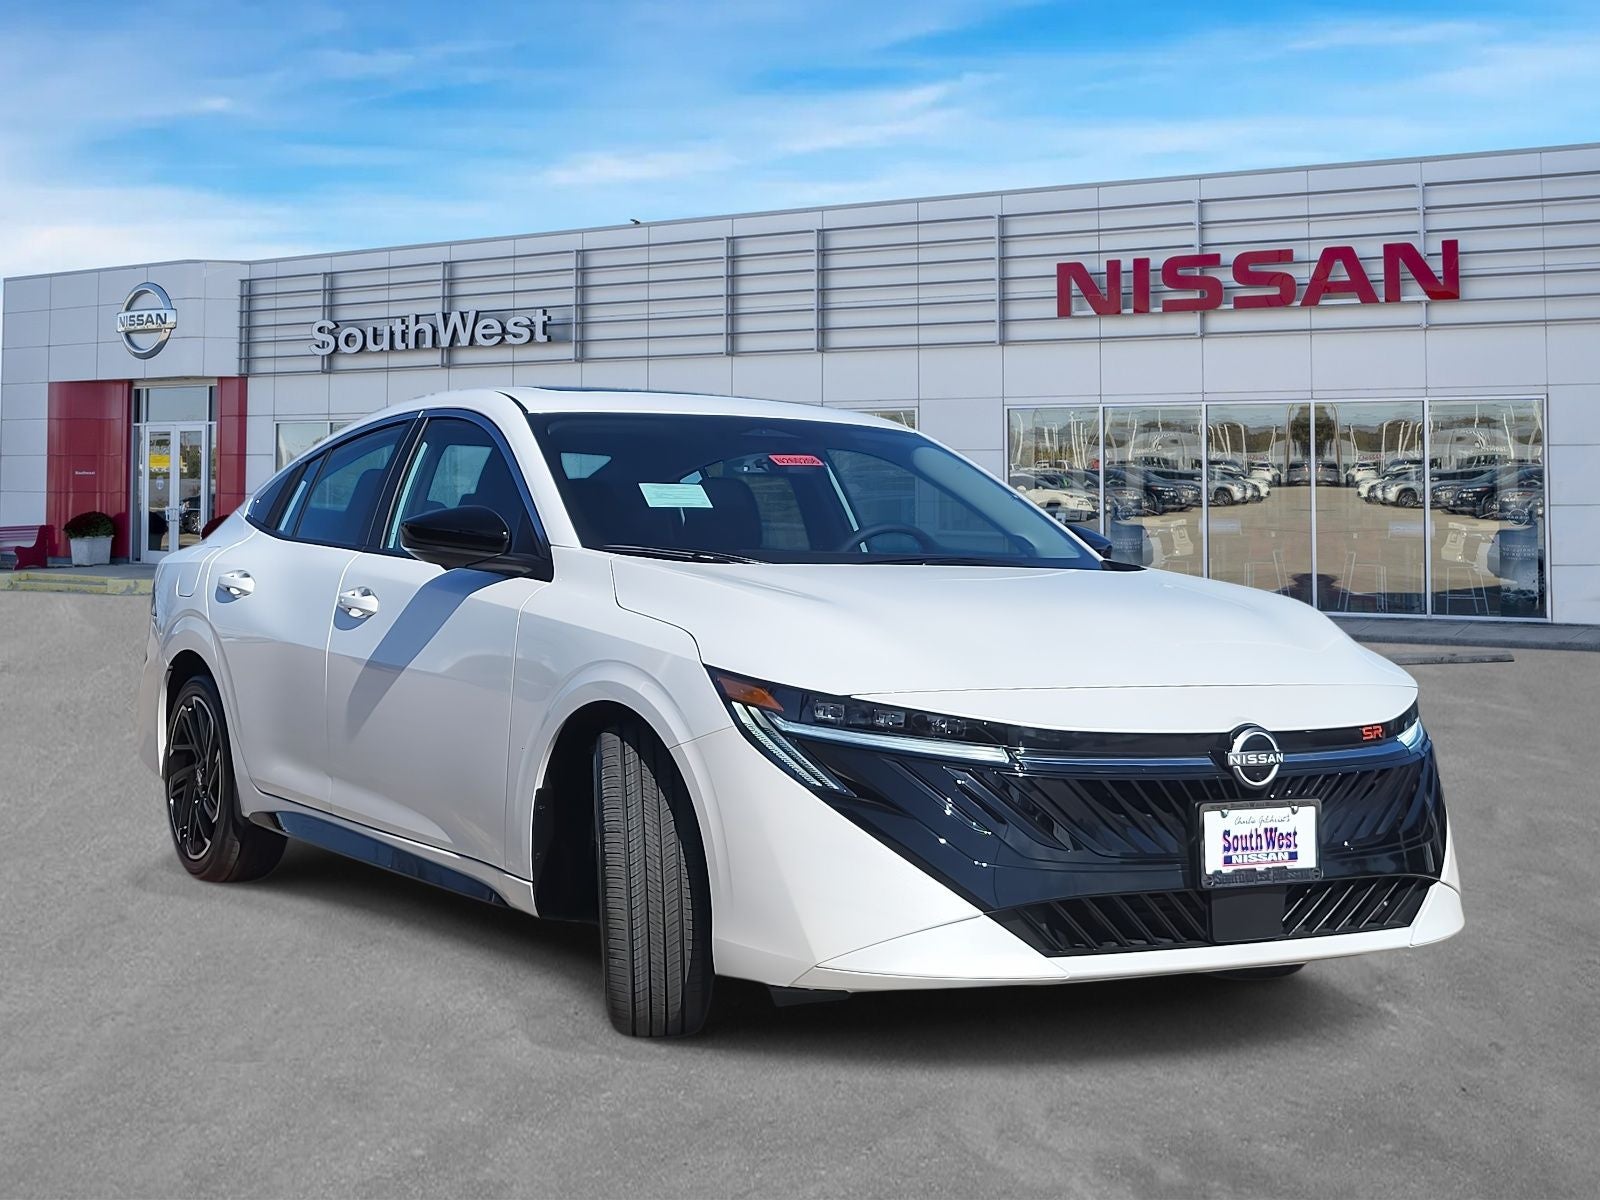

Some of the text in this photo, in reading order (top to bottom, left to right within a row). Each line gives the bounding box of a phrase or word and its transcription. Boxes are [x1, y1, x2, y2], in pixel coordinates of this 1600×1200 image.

[1056, 239, 1460, 318] NISSAN
[119, 312, 168, 328] NISSAN
[309, 309, 551, 356] SouthWest
[1361, 725, 1384, 741] SR
[1228, 752, 1284, 766] NISSAN
[1222, 827, 1298, 853] SouthWest
[1231, 852, 1289, 864] NISSAN
